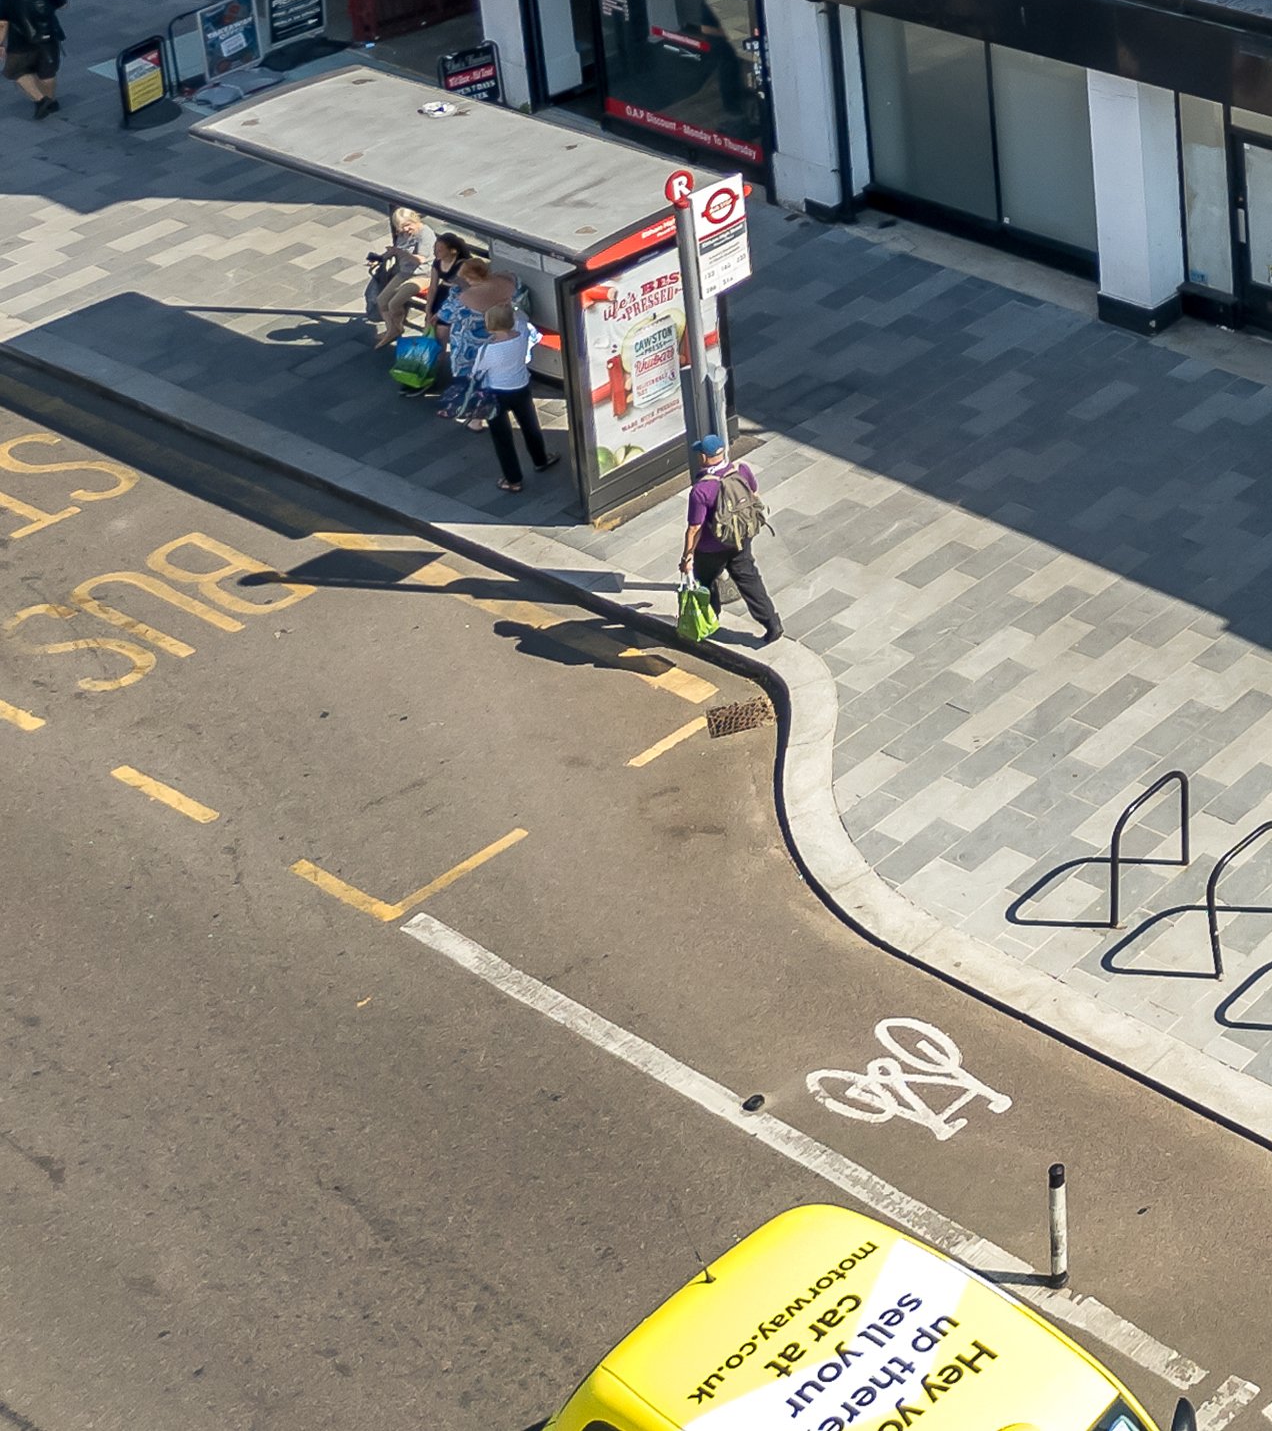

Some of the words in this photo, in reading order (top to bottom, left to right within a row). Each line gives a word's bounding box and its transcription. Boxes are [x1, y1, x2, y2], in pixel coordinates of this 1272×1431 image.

[646, 112, 677, 131] Discount
[683, 124, 712, 145] Monday
[713, 133, 722, 146] To
[723, 137, 757, 160] Thursday
[672, 175, 692, 201] R
[626, 286, 674, 322] PRESSED
[640, 271, 680, 298] BES
[634, 325, 673, 353] CAWSTON
[2, 532, 318, 691] BUS
[687, 1241, 880, 1405] motorway.co.uk
[809, 1294, 862, 1343] car
[858, 1293, 923, 1348] sell
[911, 1315, 960, 1354] up
[764, 1341, 807, 1379] at
[786, 1341, 864, 1419] your
[921, 1339, 999, 1403] Hey
